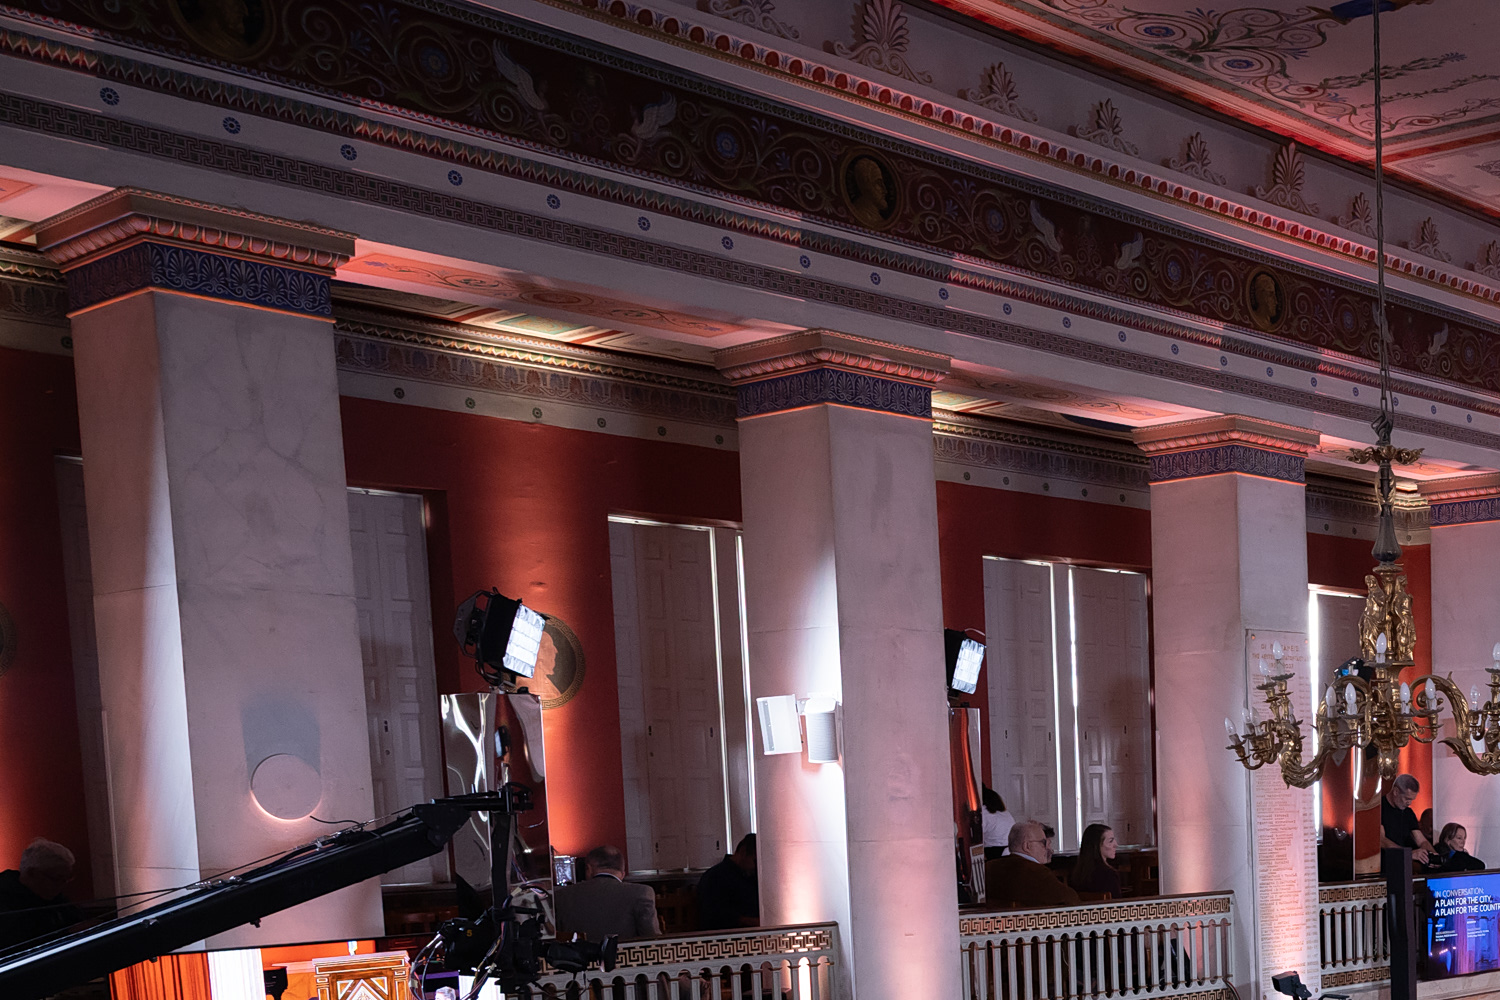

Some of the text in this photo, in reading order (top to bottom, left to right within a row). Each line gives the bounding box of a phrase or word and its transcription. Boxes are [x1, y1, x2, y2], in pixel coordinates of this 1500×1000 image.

[1440, 898, 1455, 907] PLAN
[1456, 898, 1467, 906] FOR
[1440, 908, 1455, 916] PLAN
[1456, 906, 1467, 915] FOR
[1468, 905, 1478, 913] THE
[466, 929, 473, 937] 5
